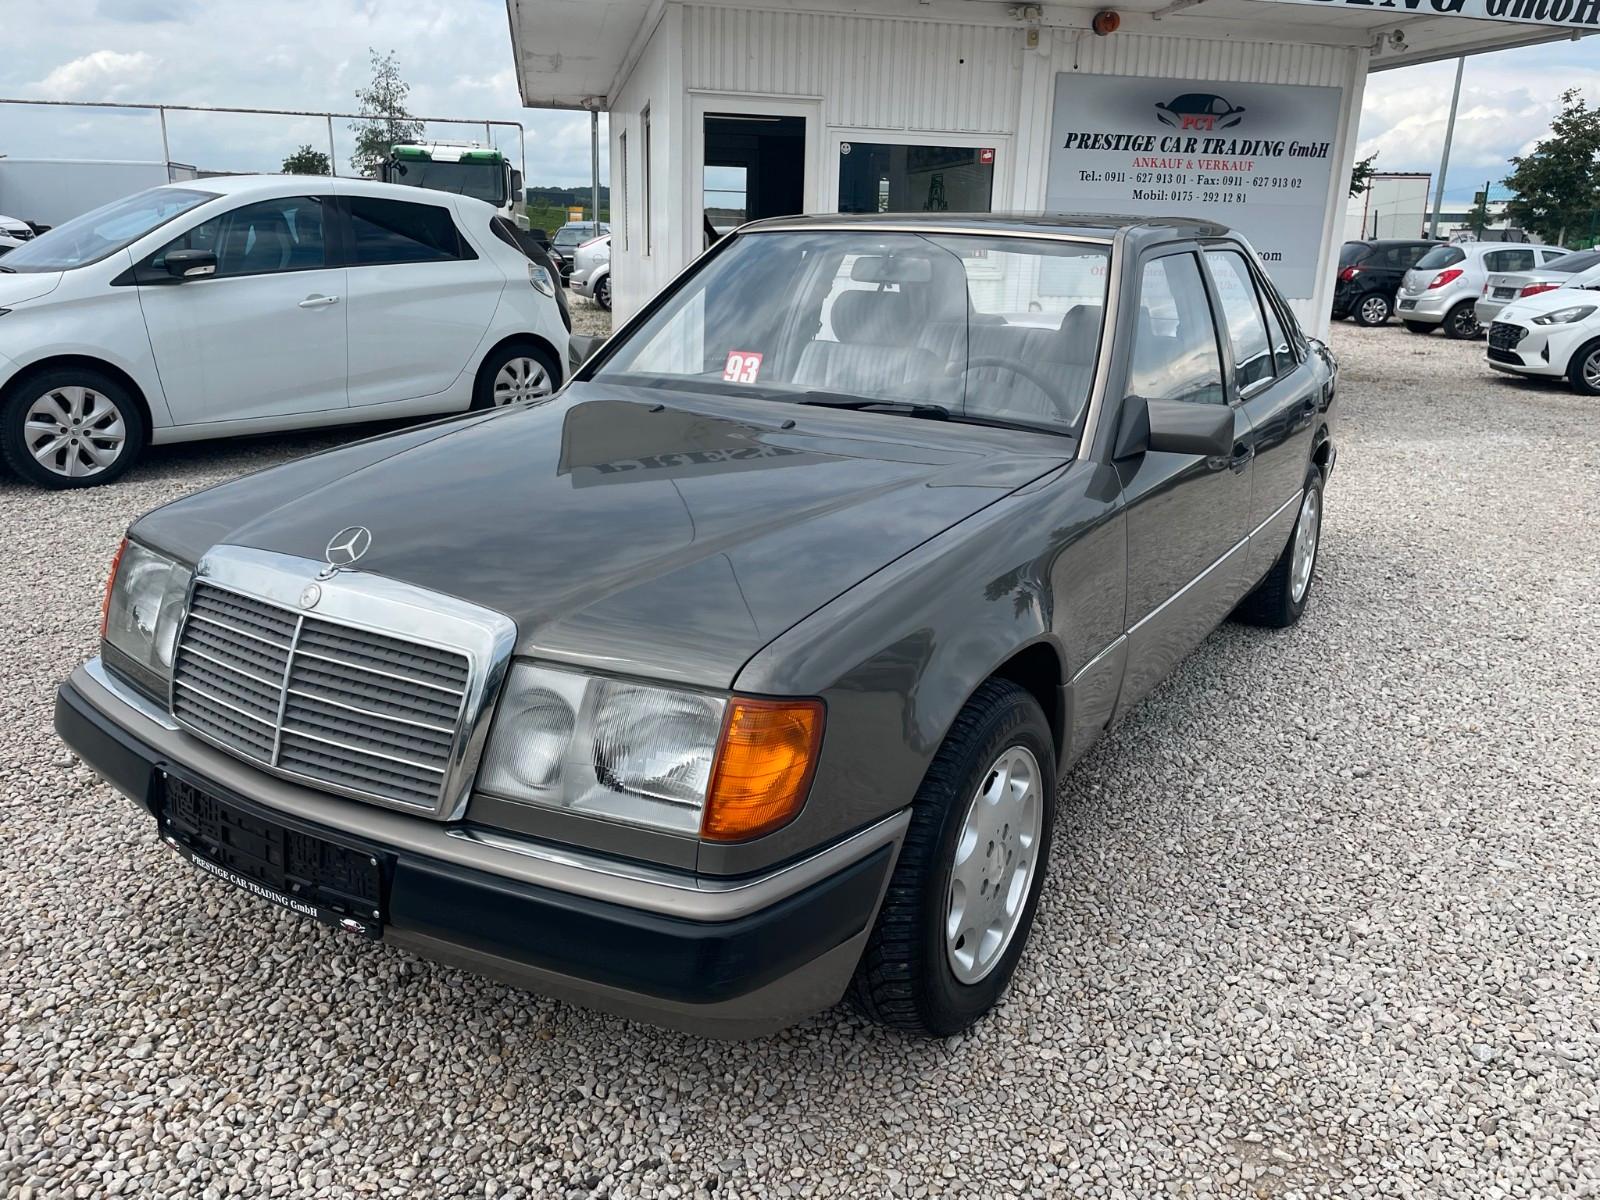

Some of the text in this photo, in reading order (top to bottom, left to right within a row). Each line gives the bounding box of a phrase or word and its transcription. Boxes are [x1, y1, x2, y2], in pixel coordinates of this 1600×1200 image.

[1182, 115, 1216, 131] PCT
[1063, 132, 1330, 158] PRESTIGE CAR TRADING GmbH
[1132, 157, 1254, 172] ANKAUF & VERKAUF
[1079, 170, 1102, 182] Tel.:
[1104, 171, 1125, 183] 0911
[1136, 172, 1153, 183] 627
[1156, 173, 1173, 184] 913
[1176, 174, 1187, 185] 01
[1197, 174, 1219, 186] Fax:
[1222, 175, 1242, 187] 0911
[1252, 176, 1269, 188] 627
[1271, 177, 1288, 188] 913
[1290, 178, 1302, 189] 02
[1132, 189, 1168, 201] Mobil:
[1171, 190, 1193, 202] 0175
[1203, 191, 1219, 202] 292
[1222, 192, 1233, 203] 12
[1236, 193, 1247, 203] 81
[723, 355, 761, 384] 93
[191, 853, 318, 917] PRESTIGE CAR TRADING GmbH
